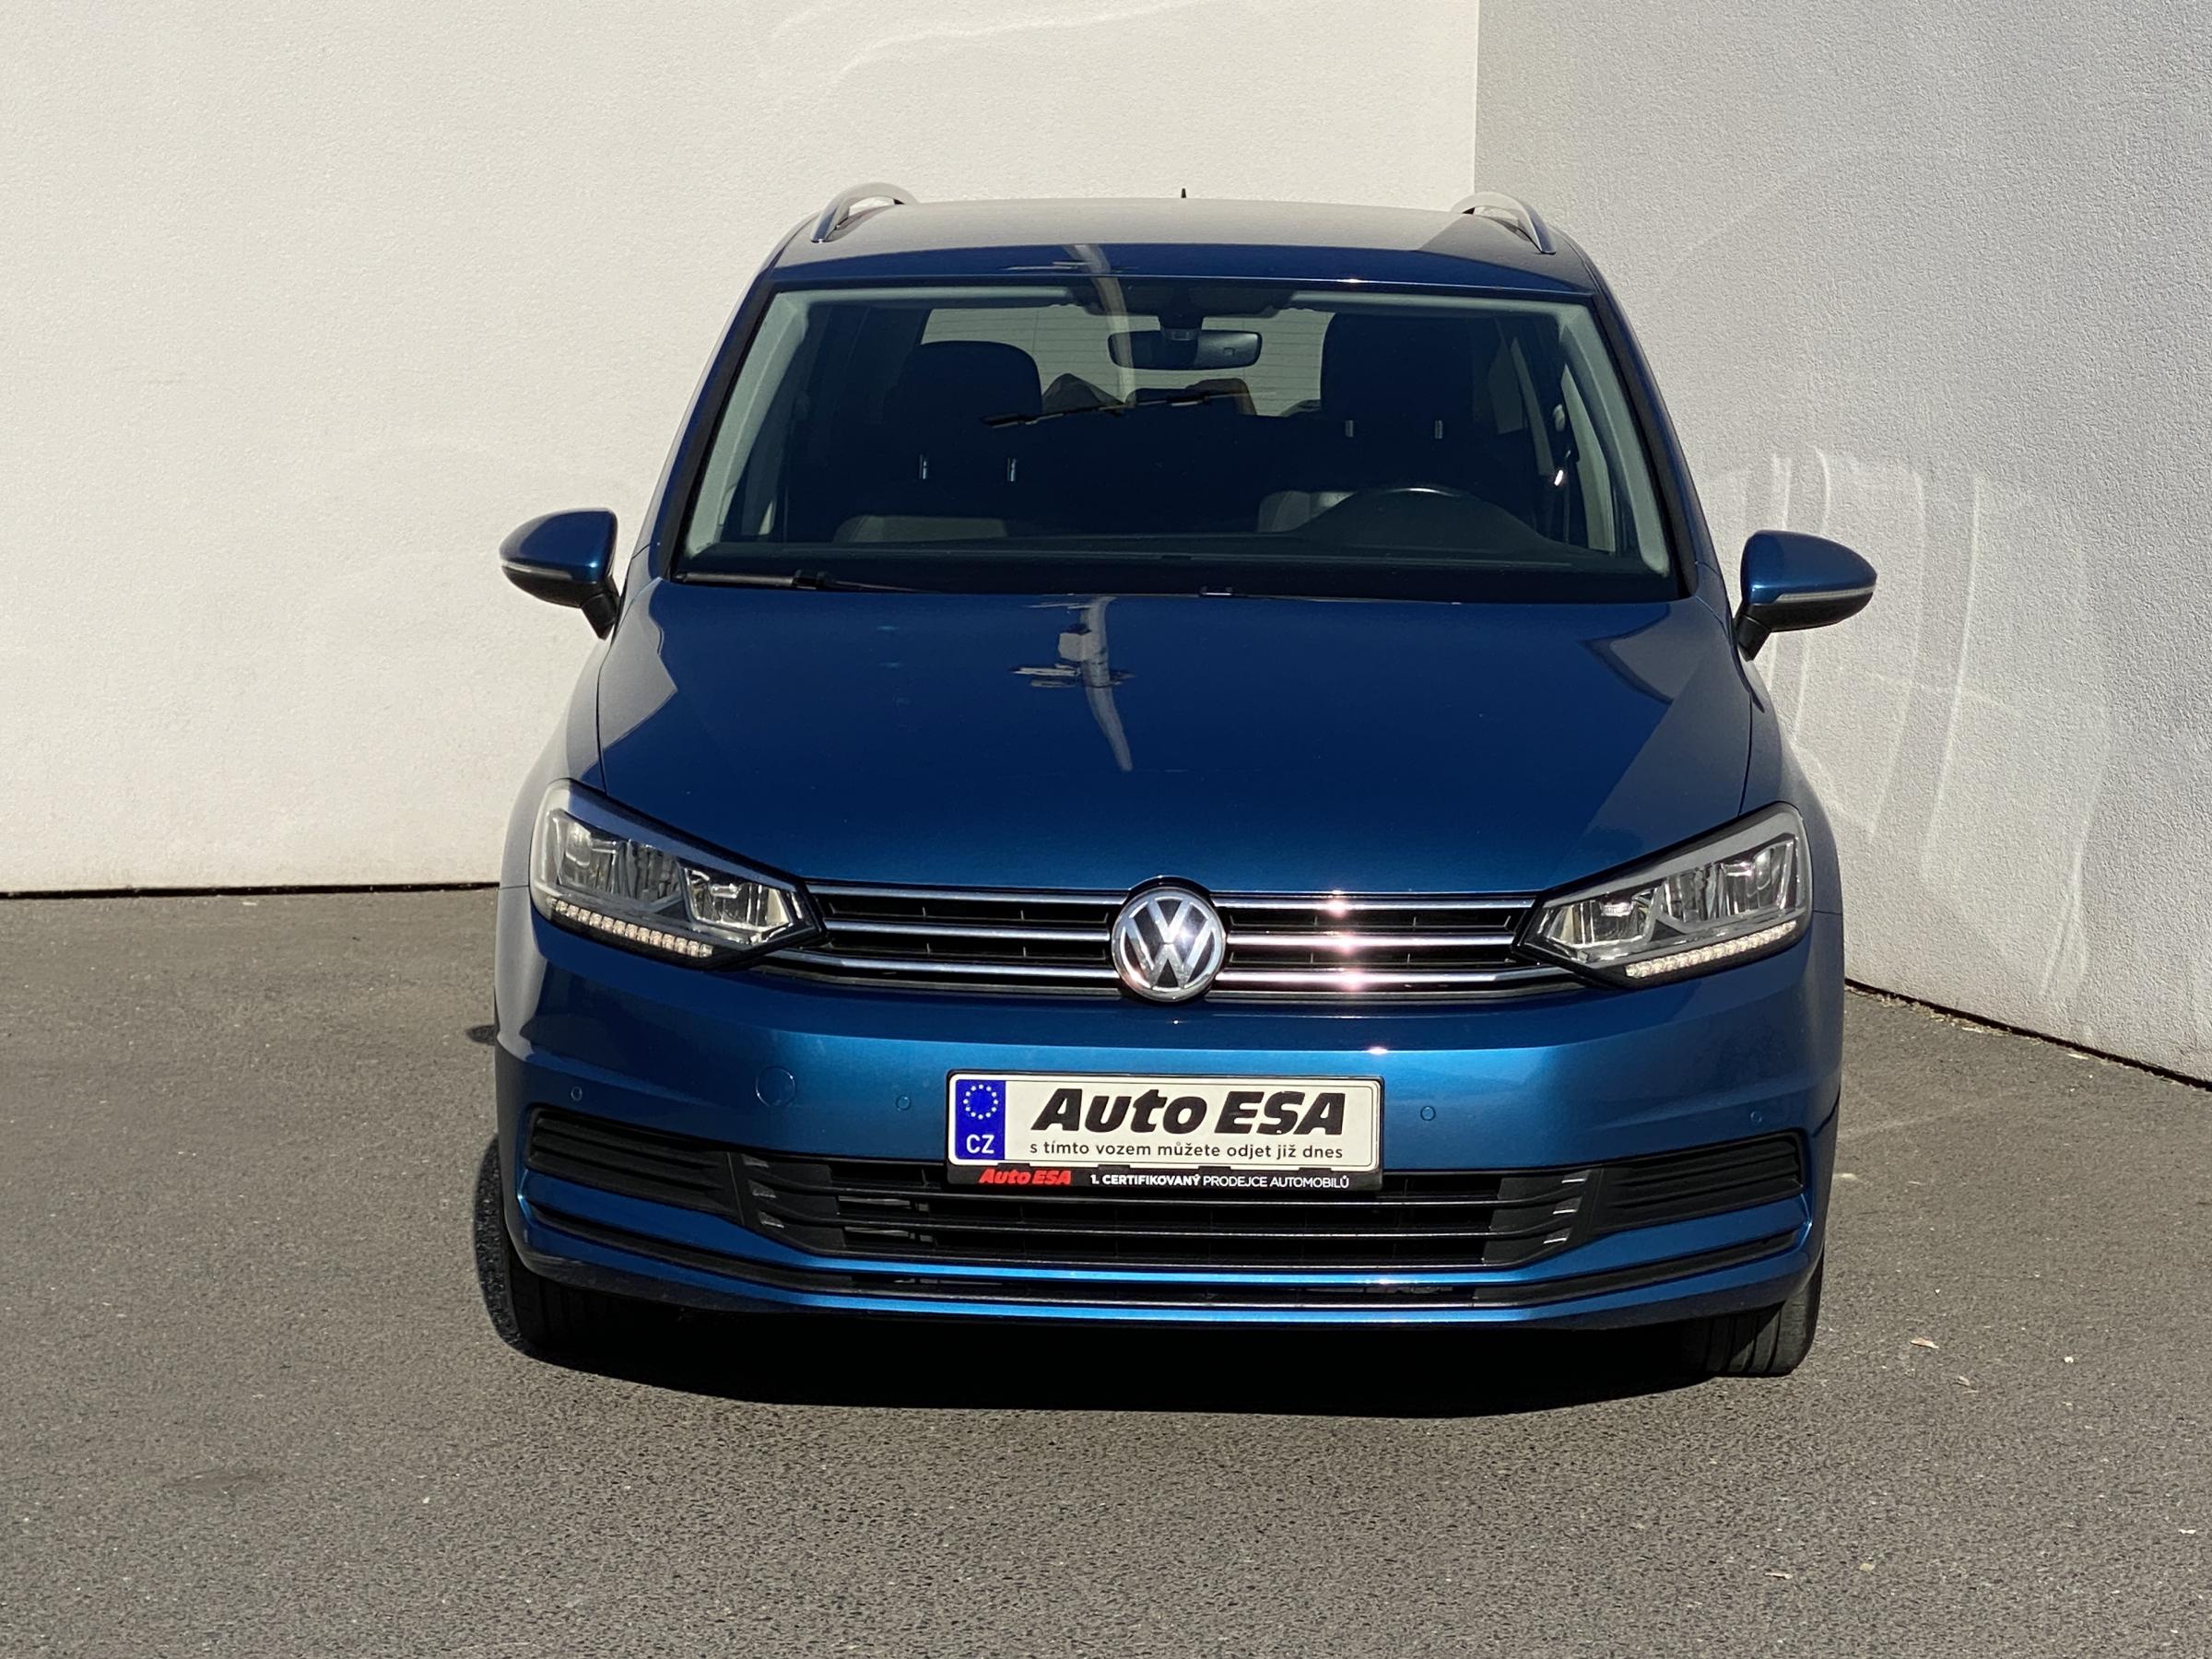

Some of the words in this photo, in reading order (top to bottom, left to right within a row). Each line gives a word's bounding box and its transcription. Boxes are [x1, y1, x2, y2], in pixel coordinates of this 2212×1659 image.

[1030, 1088, 1207, 1135] Auto
[1214, 1090, 1346, 1135] ESA
[966, 1134, 994, 1155] CZ
[1030, 1143, 1038, 1153] s
[1043, 1140, 1089, 1155] tímto
[1096, 1144, 1150, 1156] vozem
[1158, 1141, 1220, 1158] můžete
[1227, 1144, 1272, 1160] odjet
[1277, 1144, 1297, 1160] již
[1302, 1145, 1343, 1159] dnes
[978, 1169, 1030, 1184] Auto
[1031, 1170, 1072, 1185] ESA
[1090, 1174, 1100, 1184] 1.
[1101, 1173, 1201, 1186] CERTIFIKOVANÝ
[1203, 1175, 1267, 1187] PRODEJCE
[1270, 1174, 1349, 1189] AUTOMOBILŮ
